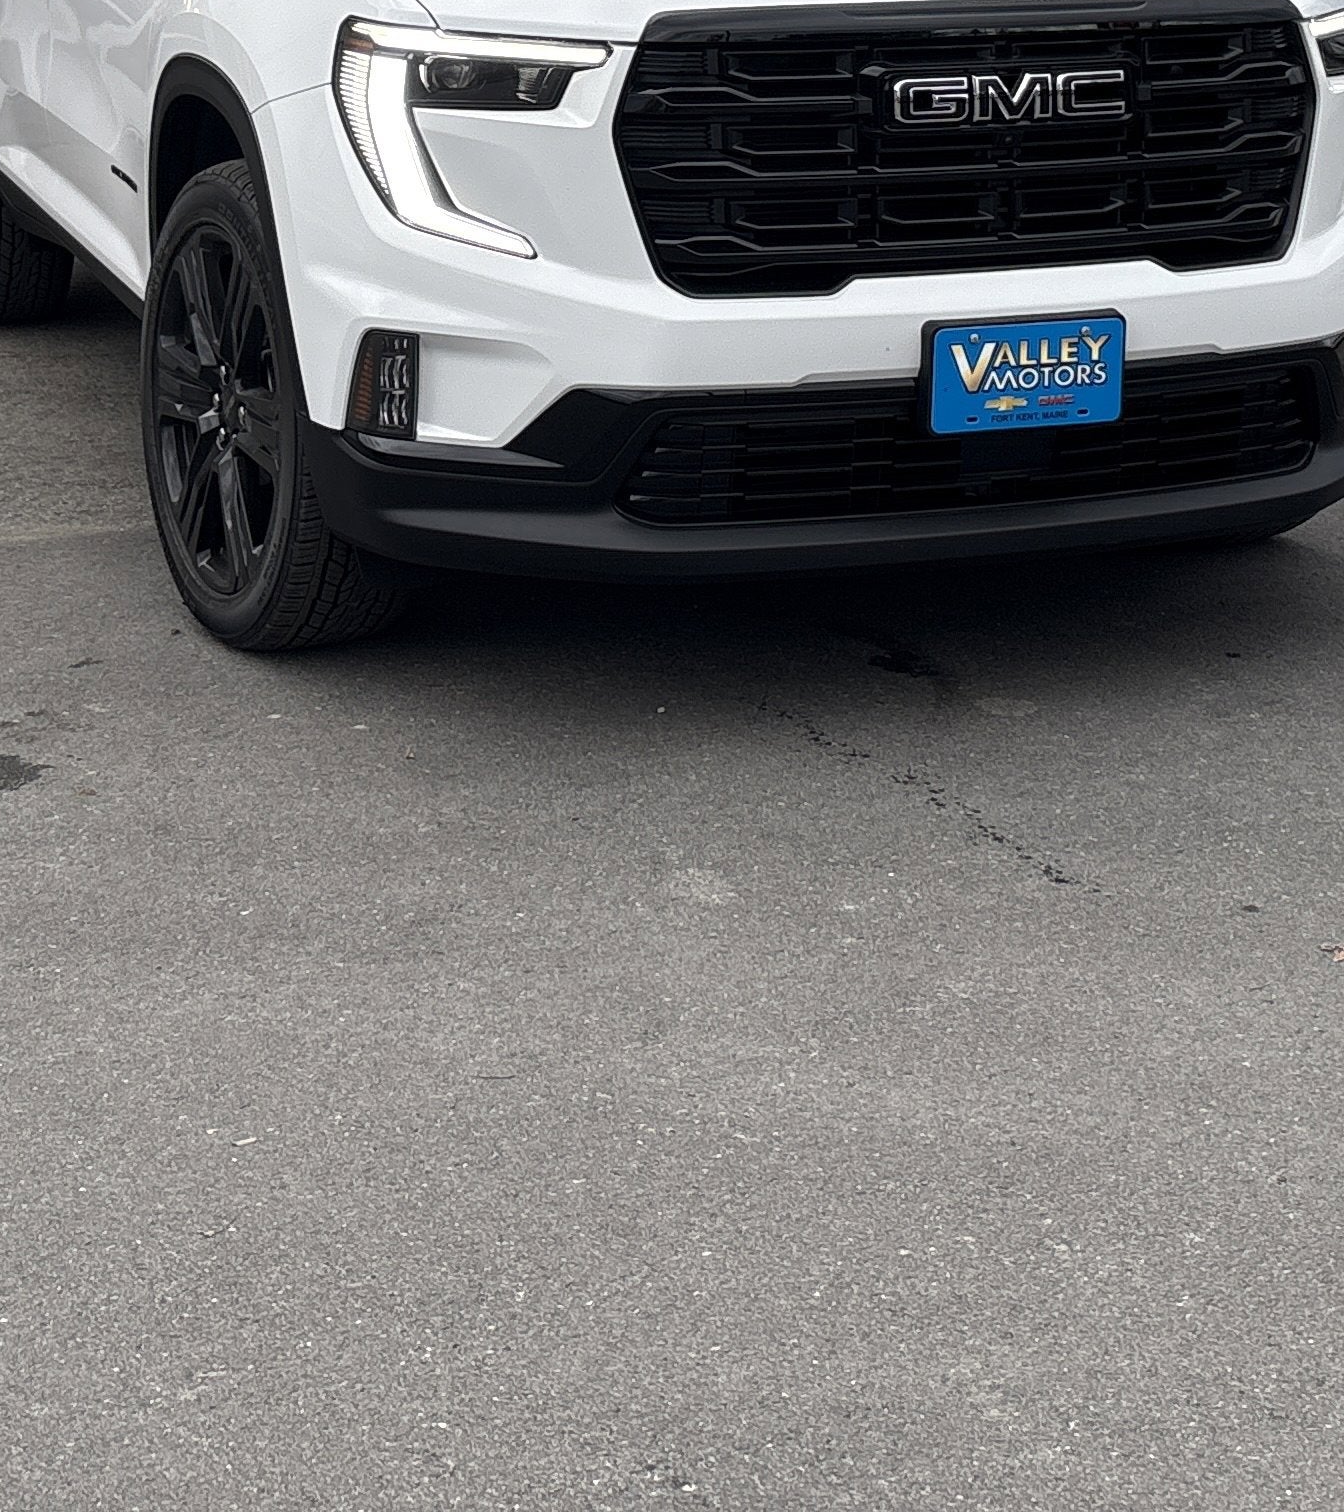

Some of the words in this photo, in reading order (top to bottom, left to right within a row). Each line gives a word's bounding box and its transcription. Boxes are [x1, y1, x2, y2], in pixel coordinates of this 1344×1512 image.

[893, 70, 1126, 124] GMC
[950, 335, 1110, 393] VALLEY
[983, 363, 1108, 392] MOTORS
[991, 412, 1013, 423] FORT
